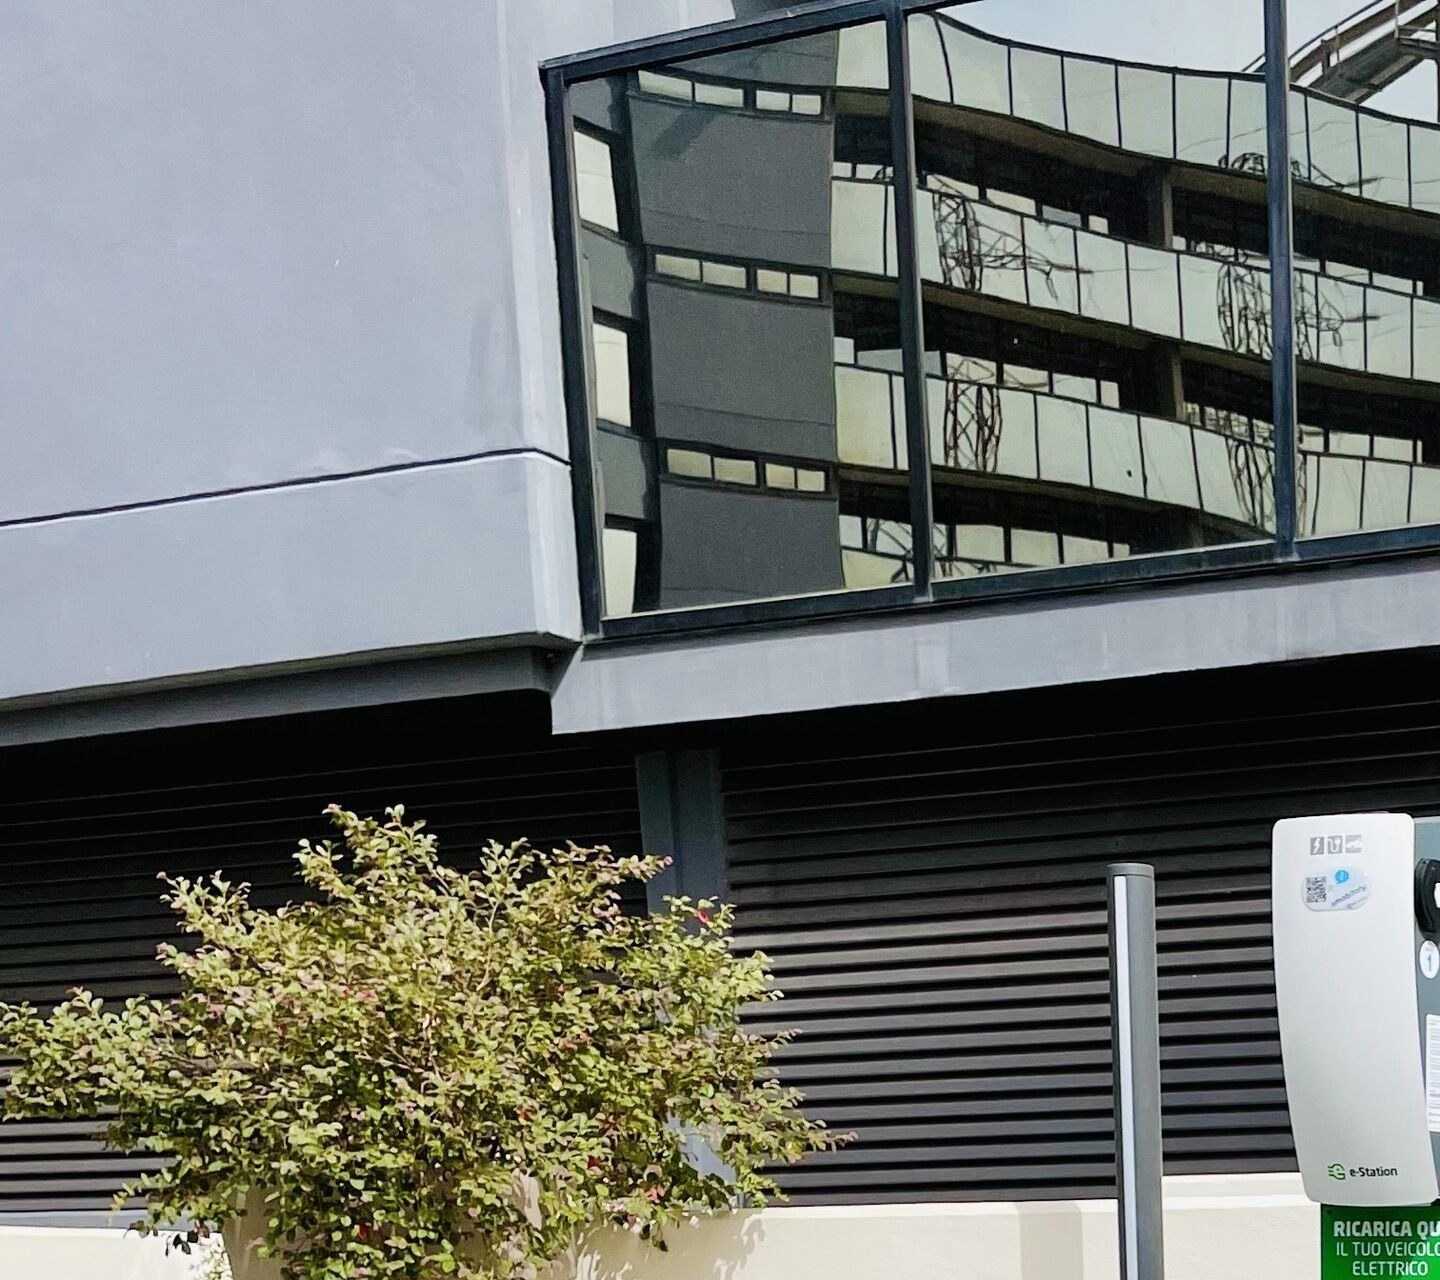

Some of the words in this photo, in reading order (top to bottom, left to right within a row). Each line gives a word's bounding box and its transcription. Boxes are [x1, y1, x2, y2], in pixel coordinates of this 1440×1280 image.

[1349, 1166, 1398, 1177] e-Station
[1333, 1220, 1413, 1237] RICARICA
[1336, 1241, 1348, 1256] IL
[1351, 1241, 1381, 1256] TUO
[1352, 1261, 1428, 1276] ELETTRICO
